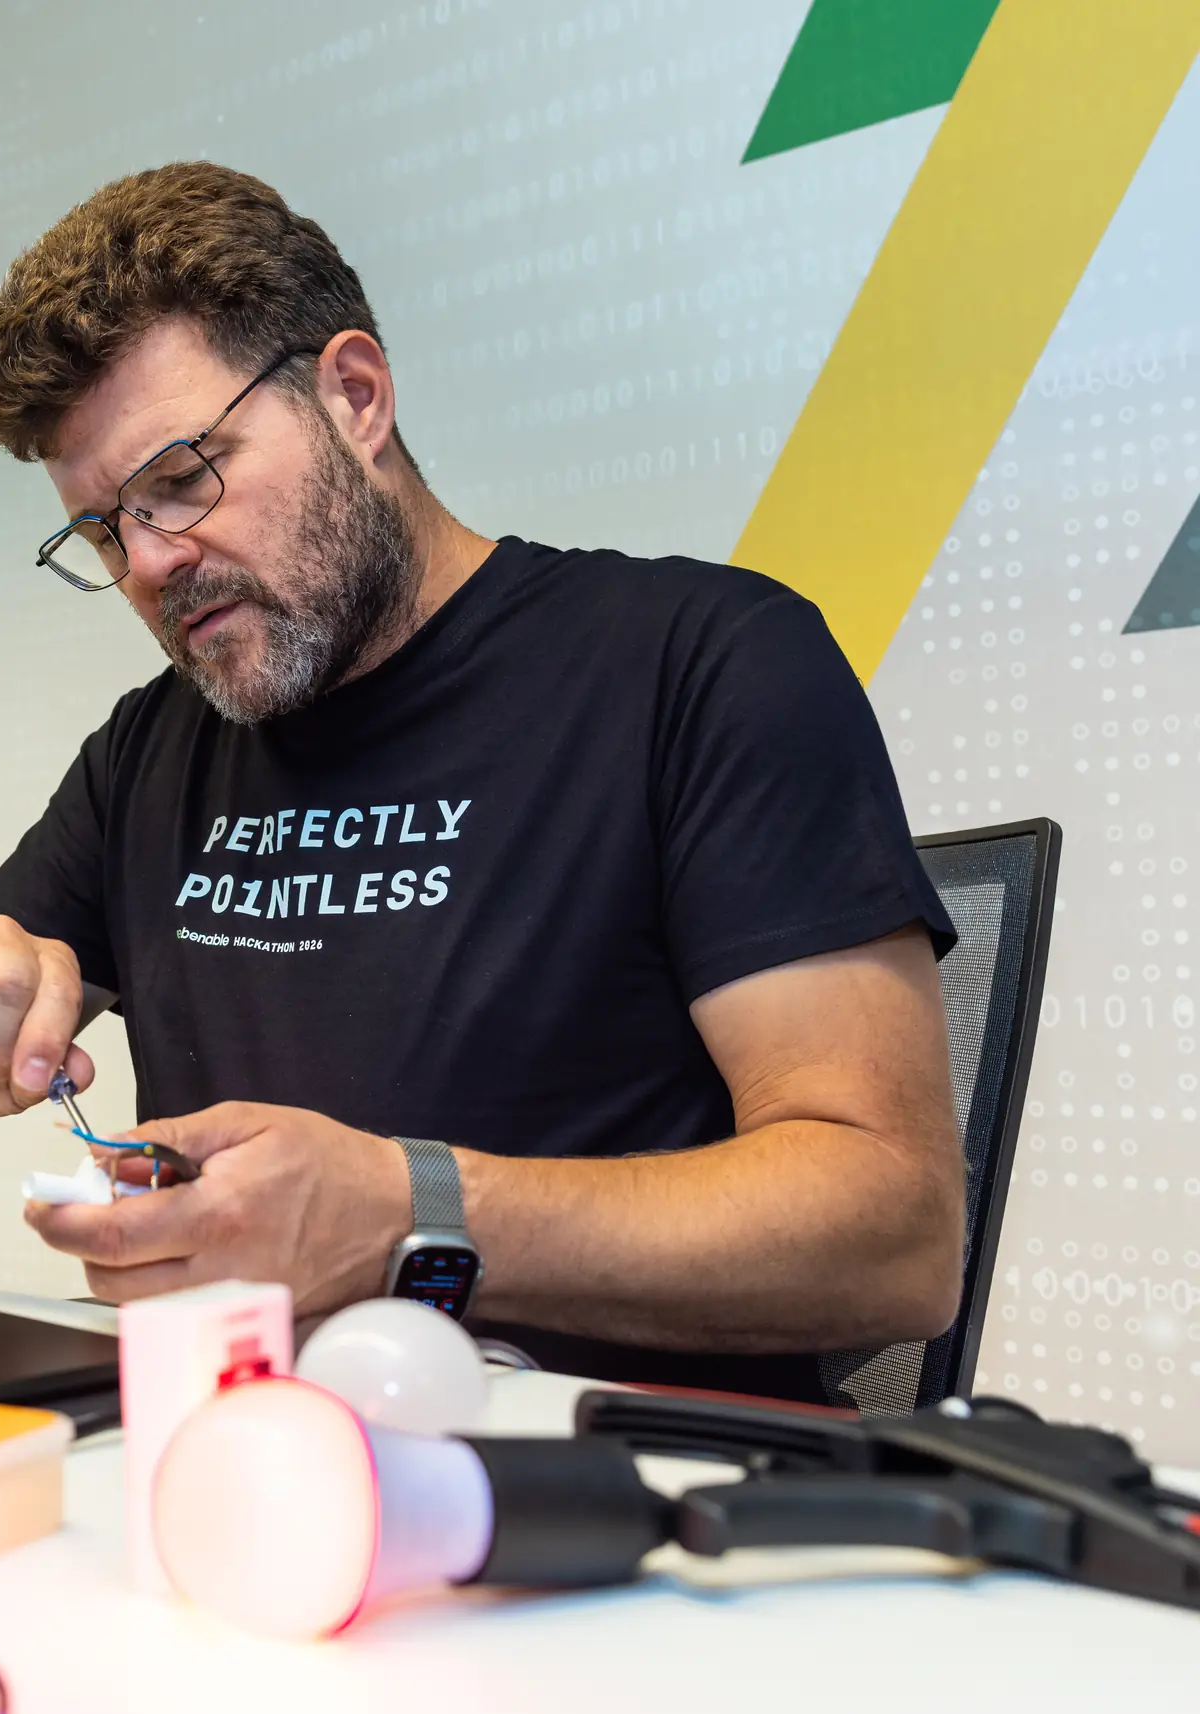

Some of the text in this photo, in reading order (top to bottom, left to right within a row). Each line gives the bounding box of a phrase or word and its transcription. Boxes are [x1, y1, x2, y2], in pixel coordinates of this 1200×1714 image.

[202, 799, 472, 855] PERFECTLY
[233, 936, 295, 953] HACKATHON
[299, 939, 323, 951] 2026
